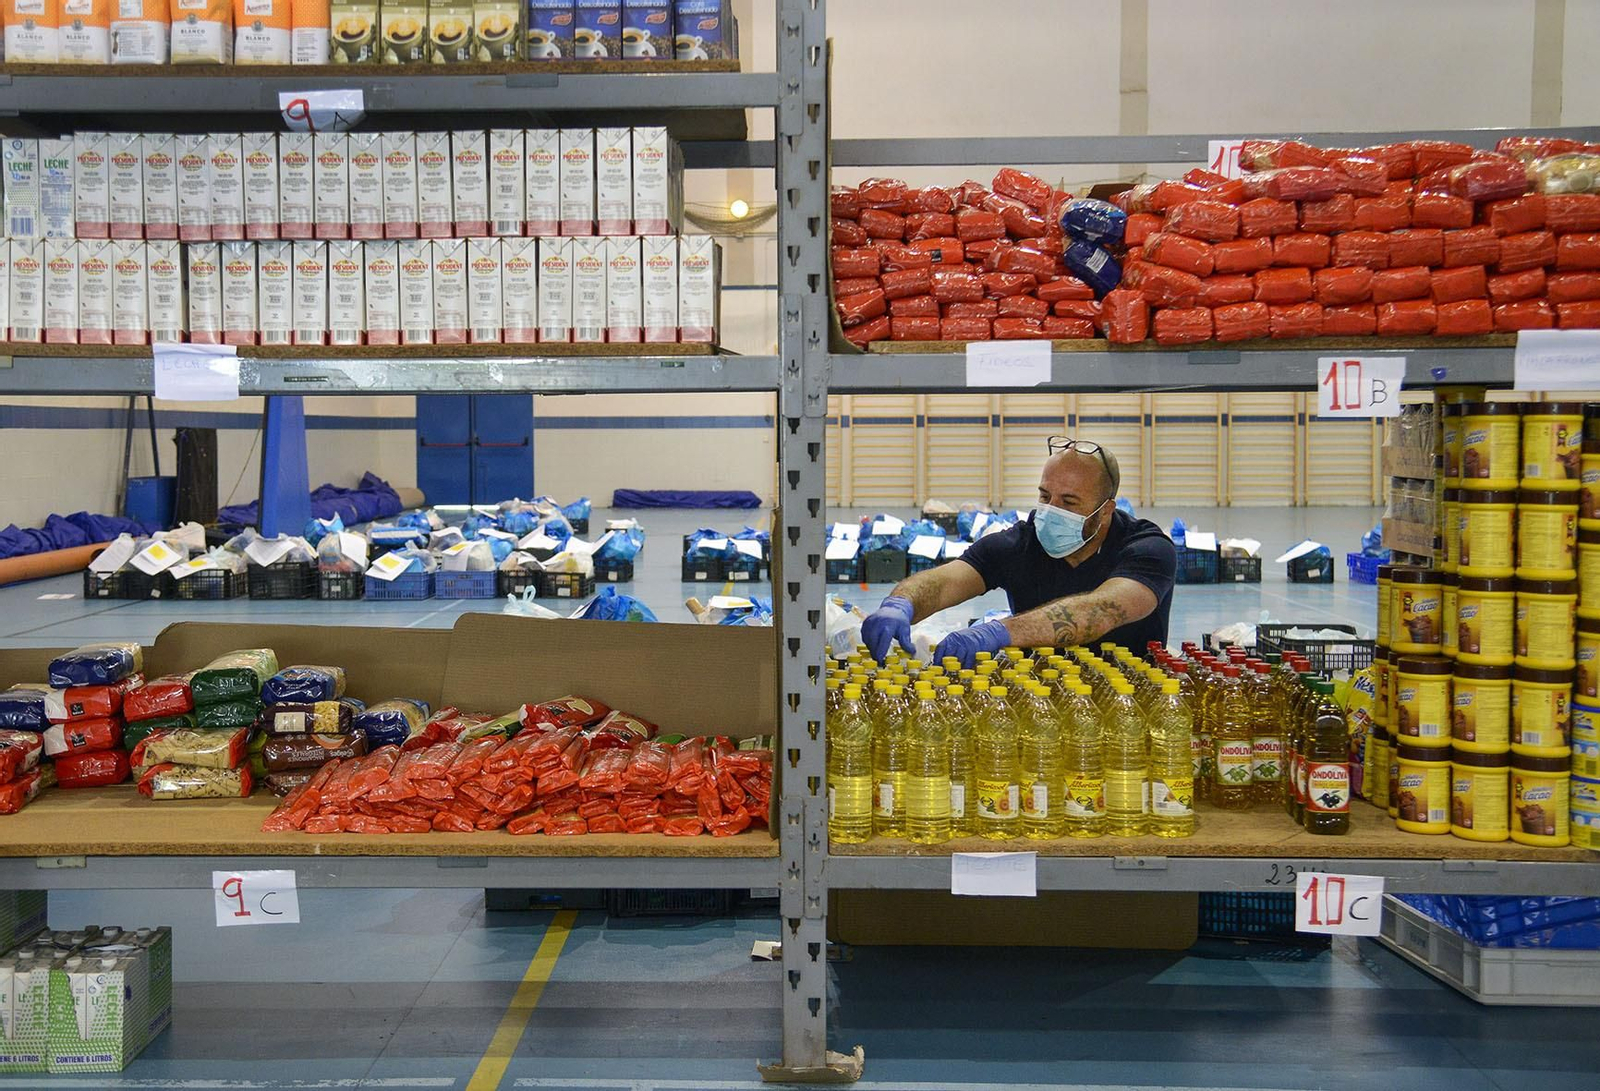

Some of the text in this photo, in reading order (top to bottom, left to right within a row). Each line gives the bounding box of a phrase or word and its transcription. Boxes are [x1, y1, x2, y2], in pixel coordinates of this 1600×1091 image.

[9, 162, 32, 172] LECHE
[44, 159, 69, 169] LECHE
[1322, 361, 1388, 411] 10 B
[1413, 602, 1438, 613] Cacao
[1523, 791, 1552, 800] Cacao
[222, 878, 283, 916] 9 C
[1302, 876, 1369, 926] 10 C
[33, 986, 44, 1030] LECHE
[107, 986, 118, 1030] LECHE
[56, 1056, 85, 1064] CONTIENE
[92, 1054, 113, 1062] LITROS
